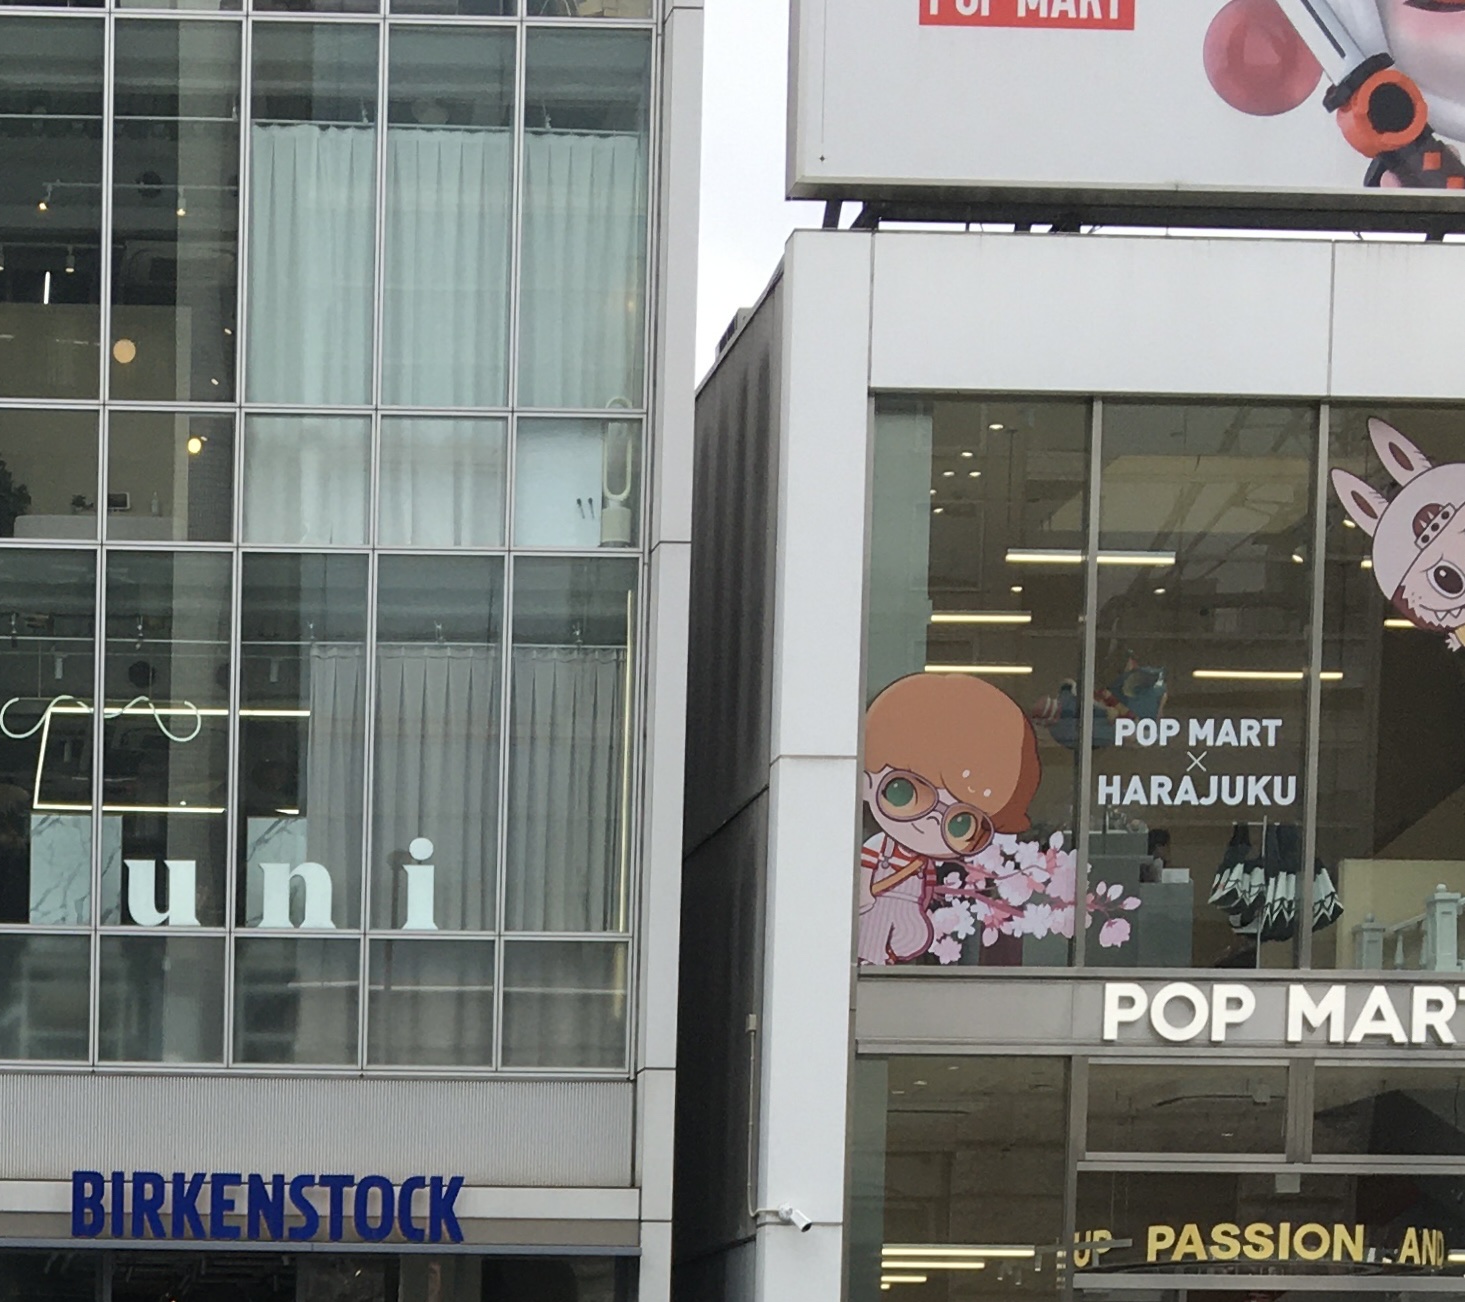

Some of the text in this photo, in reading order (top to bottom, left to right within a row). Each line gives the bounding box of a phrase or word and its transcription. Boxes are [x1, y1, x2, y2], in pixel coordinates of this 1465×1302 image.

[1115, 718, 1283, 746] POP MART
[1097, 774, 1297, 806] HARAJUKU
[1102, 981, 1465, 1044] POP MAR
[71, 1170, 465, 1243] BIRKENSTOCK
[1146, 1222, 1365, 1263] PASSION
[1399, 1226, 1445, 1267] AND
